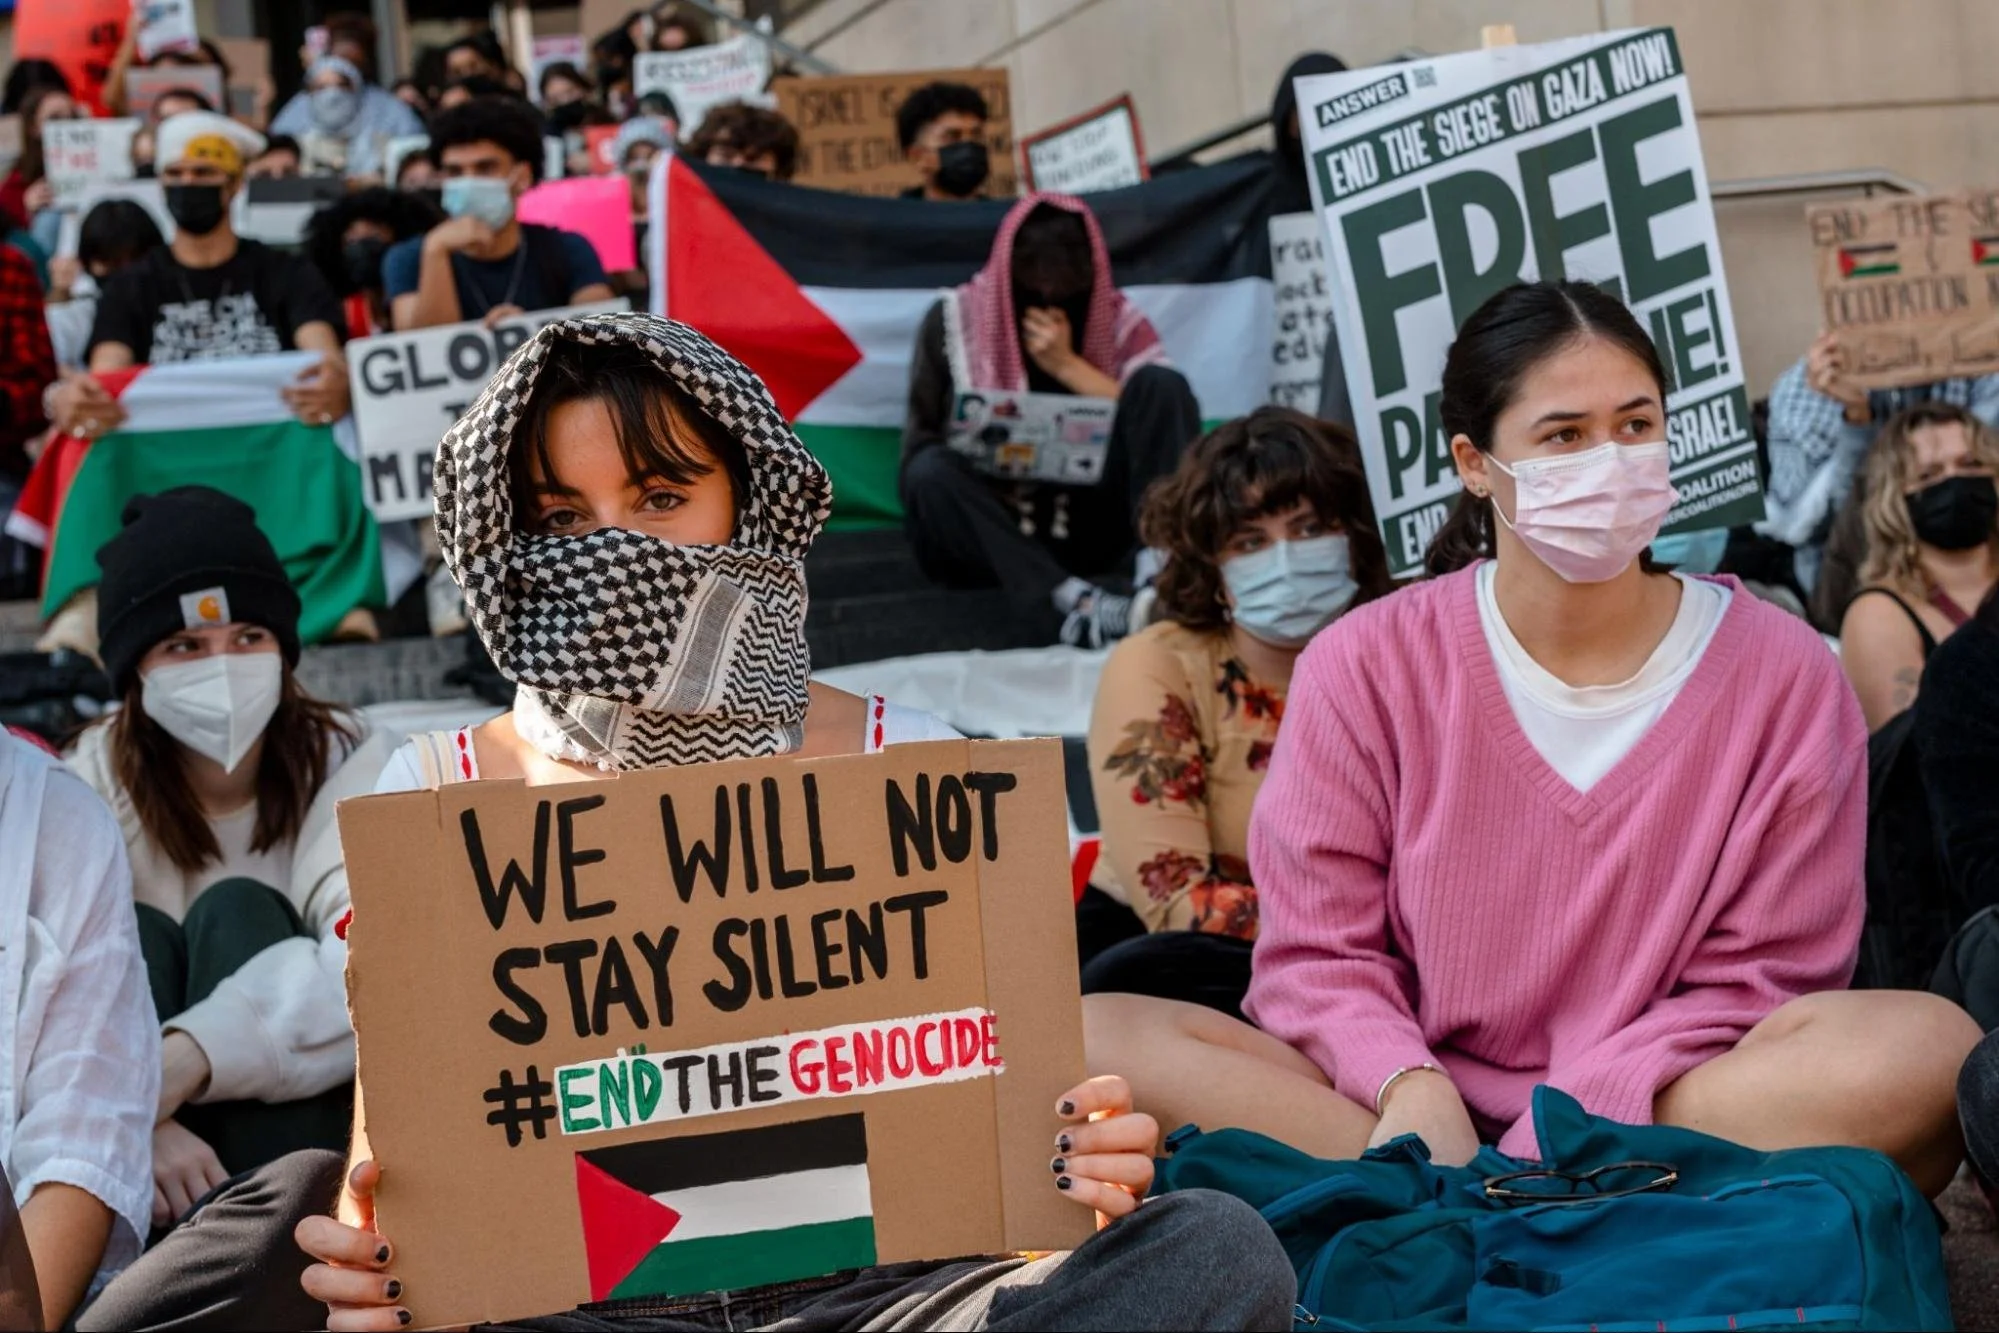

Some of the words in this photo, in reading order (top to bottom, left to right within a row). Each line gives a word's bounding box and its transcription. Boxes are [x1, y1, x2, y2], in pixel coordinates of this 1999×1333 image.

[1320, 77, 1405, 125] ANSWER
[1326, 141, 1379, 198] END
[1380, 121, 1432, 175] THE
[1433, 94, 1505, 158] SIEGE
[1506, 80, 1542, 132] ON
[1542, 56, 1607, 122] GAZA
[1608, 32, 1676, 96] NOW!
[1340, 94, 1711, 400] FREE
[362, 319, 553, 395] GLOB
[1667, 396, 1747, 463] SRAEL
[1678, 459, 1756, 504] OALITION
[461, 794, 616, 931] WE
[660, 773, 855, 903] WILL
[886, 772, 1017, 877] NOT
[488, 926, 681, 1045] STAY
[702, 890, 948, 1011] SILENT
